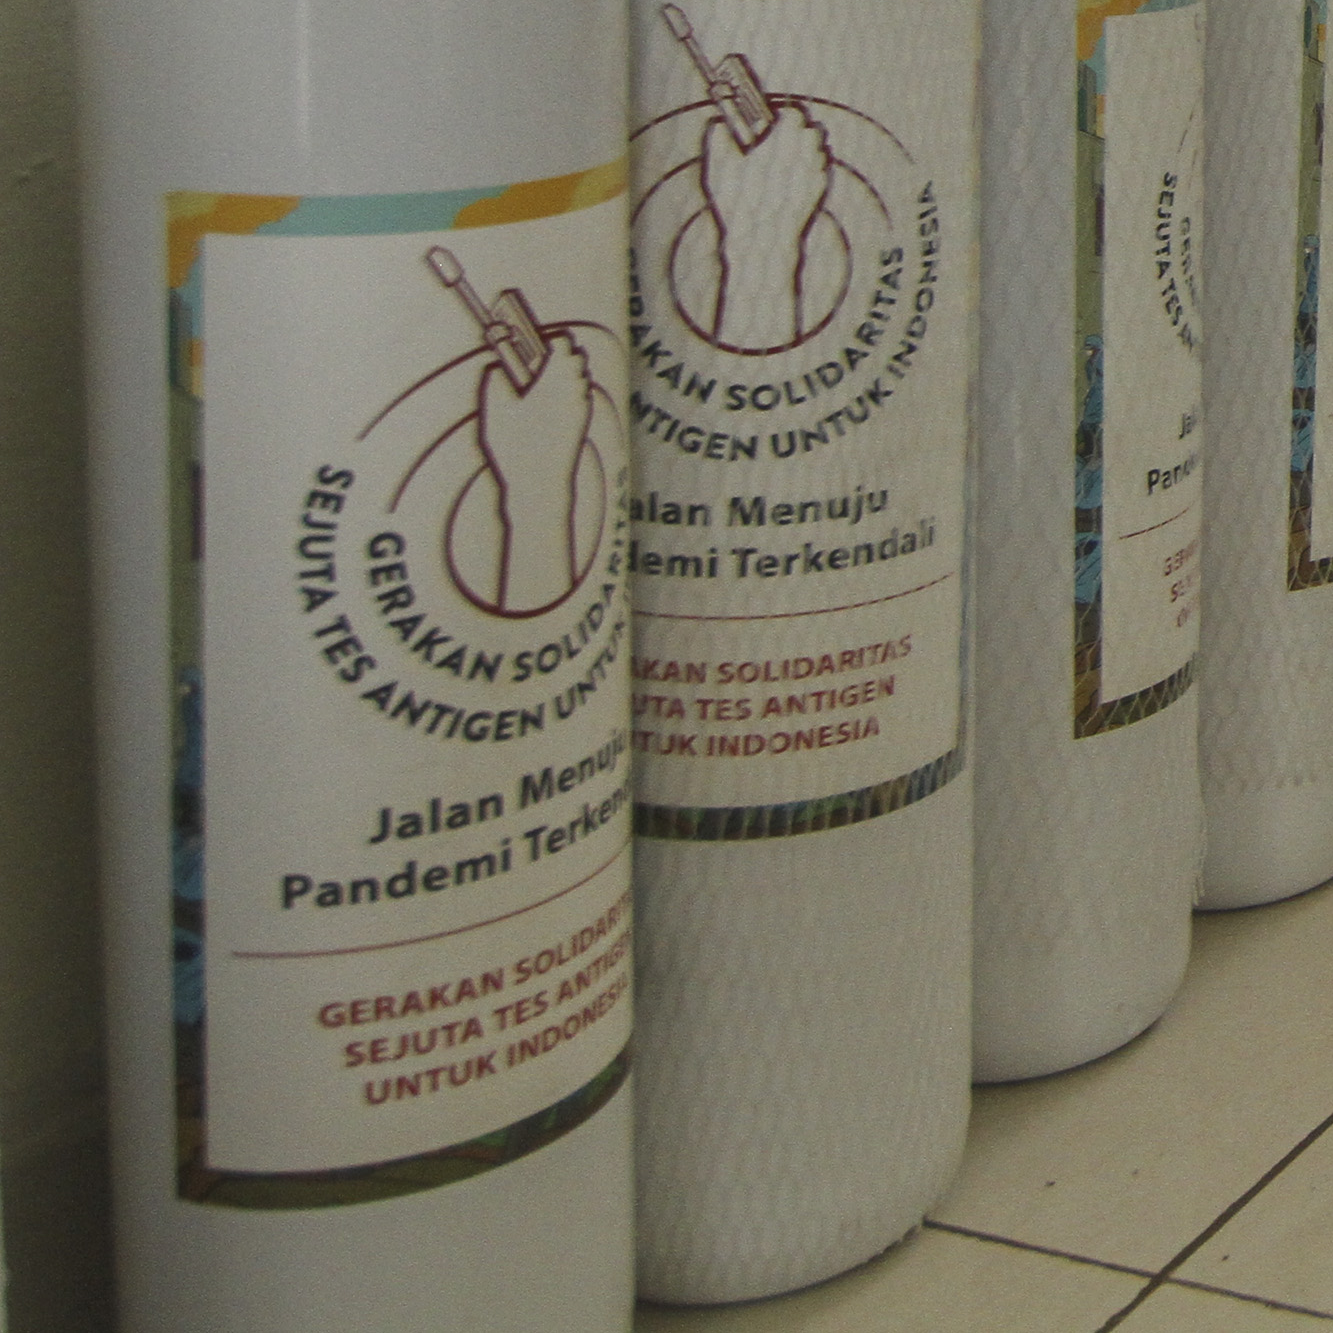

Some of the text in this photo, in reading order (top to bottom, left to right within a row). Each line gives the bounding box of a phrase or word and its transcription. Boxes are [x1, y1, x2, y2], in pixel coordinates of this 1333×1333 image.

[1156, 171, 1178, 280] SEJUTA
[727, 246, 904, 413] SOLIDARITAS
[770, 385, 896, 460] UNTUK
[886, 180, 941, 380] INDONESIA
[296, 463, 355, 613] SEJUTA
[629, 484, 889, 528] alan Menuju
[731, 515, 938, 579] Terkendali
[366, 530, 504, 684] GERAKAN
[314, 615, 376, 685] TES
[717, 632, 914, 685] SOLIDARITAS
[361, 679, 546, 743] ANTIGEN
[695, 696, 753, 722] TES
[761, 674, 897, 721] ANTIGEN
[706, 714, 881, 758] INDONESIA
[369, 792, 504, 844] Jalan
[280, 837, 513, 911] Pandemi
[317, 966, 505, 1030] GERAKAN
[344, 1019, 485, 1068] SEJUTA
[493, 989, 548, 1032] TES
[362, 1049, 498, 1108] UNTUK
